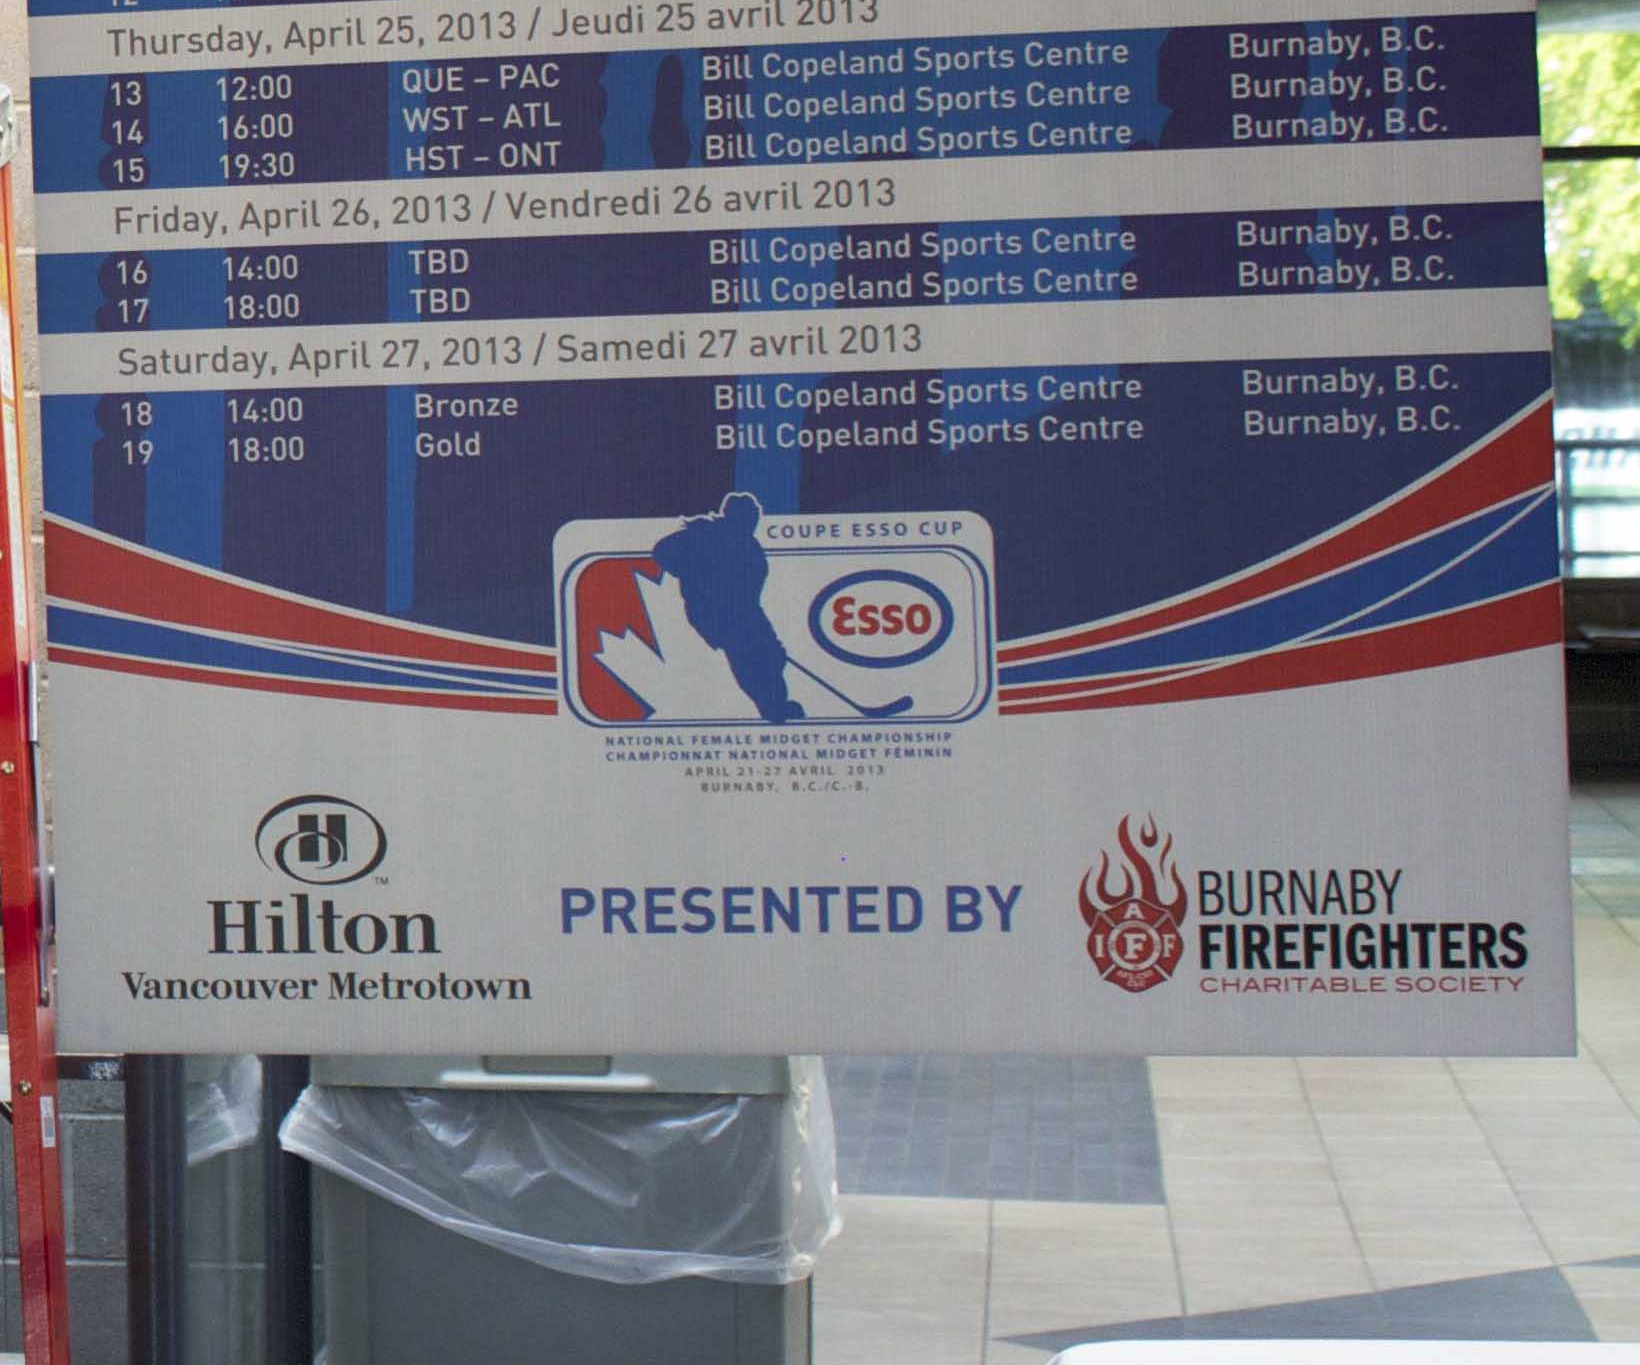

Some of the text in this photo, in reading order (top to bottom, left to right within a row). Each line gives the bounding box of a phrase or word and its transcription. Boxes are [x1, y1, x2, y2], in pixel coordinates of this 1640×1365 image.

[119, 323, 921, 379] Saturday, April 27, 2013 / Samedi 27 avril 2013
[716, 375, 1141, 413] Bill Copeland Sports Centre
[1243, 364, 1458, 398] Burnaby, B.C.
[122, 402, 152, 425] 18
[228, 397, 302, 423] 14:00
[414, 393, 518, 418] Bronze
[767, 521, 962, 539] COUPE ESSO CUP
[833, 597, 931, 635] Esso
[606, 732, 951, 746] NATIONAL FEMALE MIDGET CHAMPIONSHIP
[562, 885, 1021, 933] PRESENTED BY
[1199, 869, 1401, 916] BURNABY
[208, 894, 440, 954] Hilton
[1200, 922, 1527, 969] FIREFIGHTERS
[122, 972, 531, 999] Vancouver Metrotown
[1200, 976, 1524, 993] CHARITABLE SOCIETY
